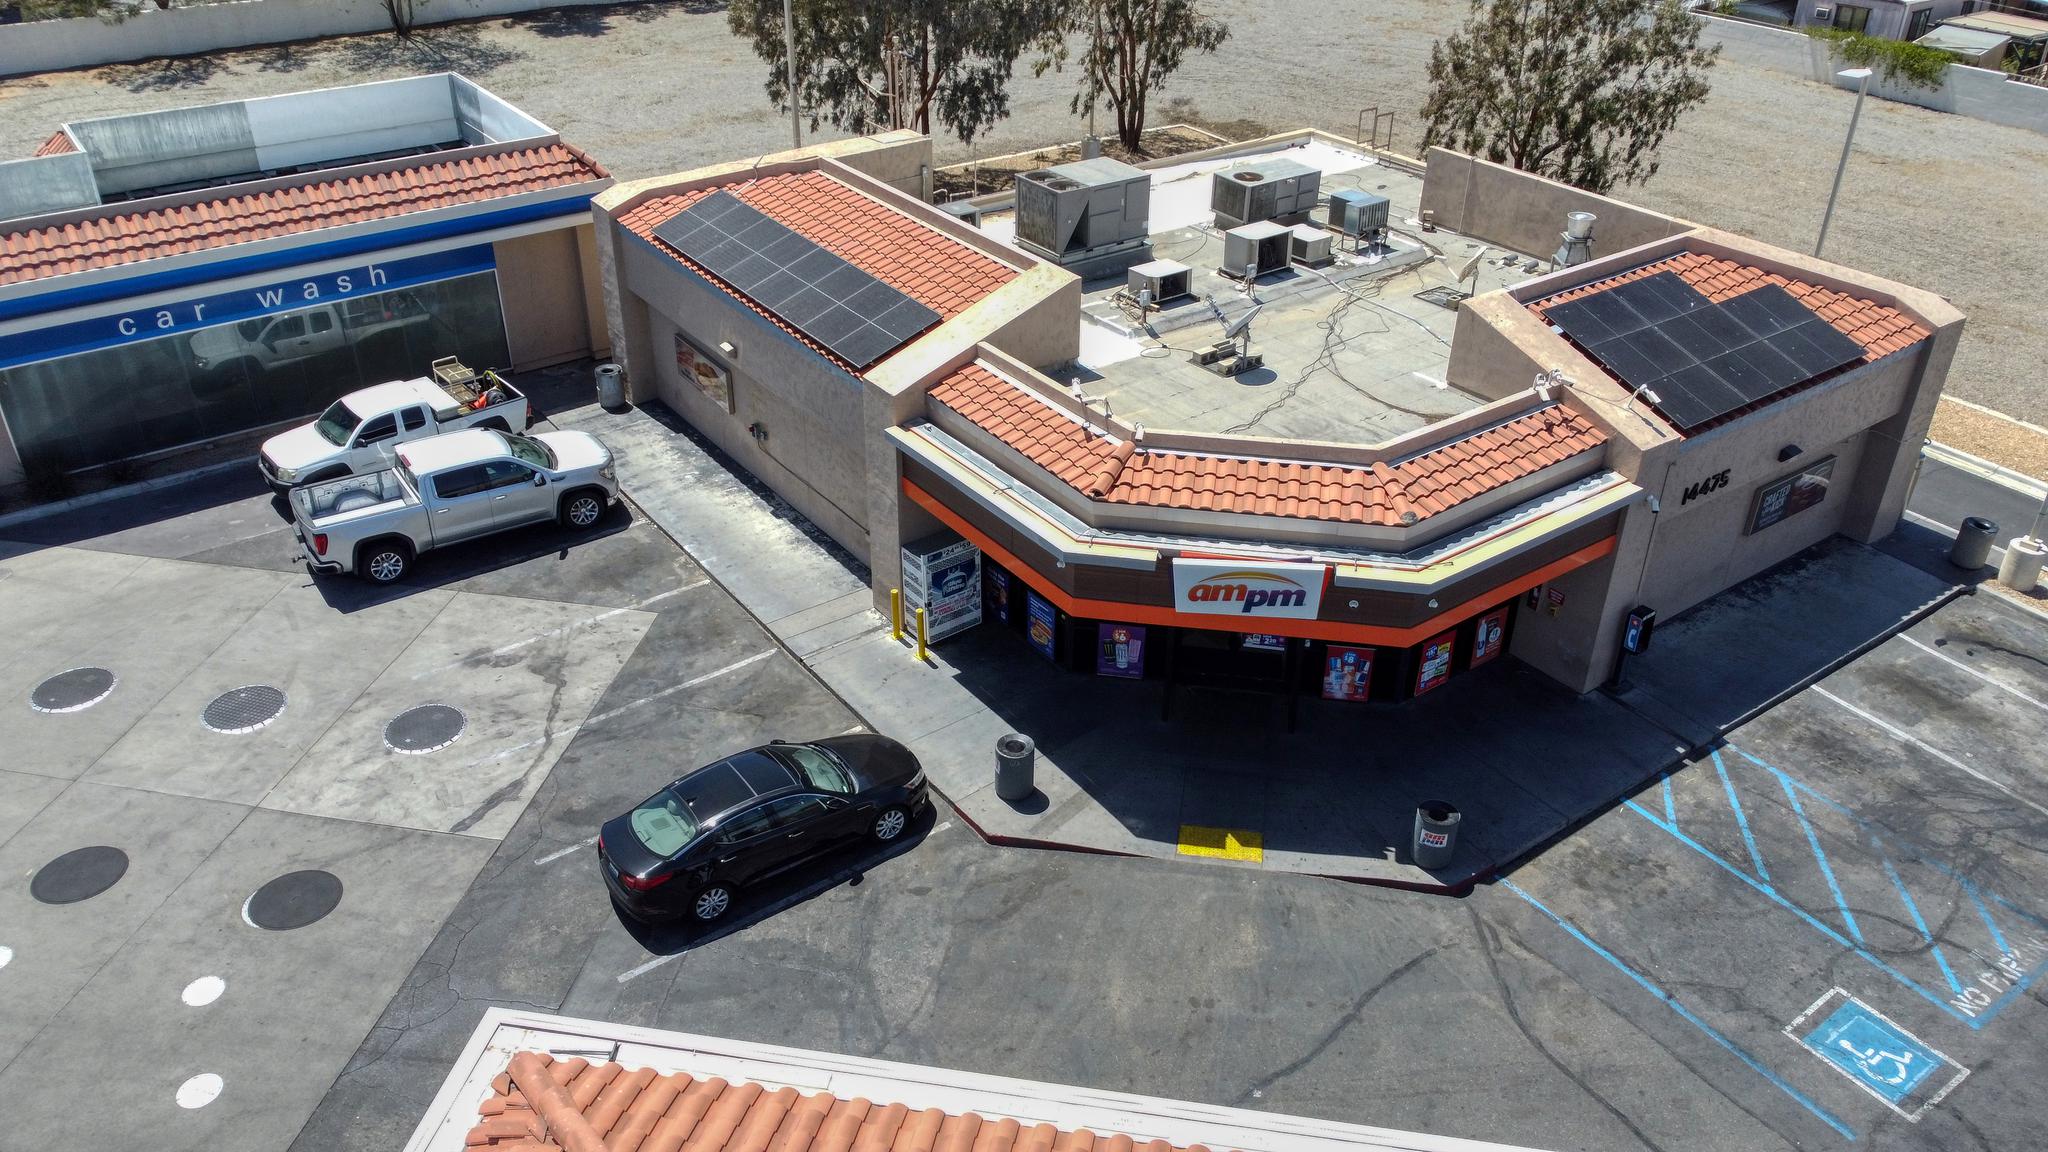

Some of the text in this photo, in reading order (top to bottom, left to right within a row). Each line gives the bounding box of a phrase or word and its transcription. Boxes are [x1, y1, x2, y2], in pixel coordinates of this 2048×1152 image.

[118, 265, 386, 336] car wash
[1681, 468, 1731, 506] 14475
[1188, 583, 1305, 614] ampm
[1950, 987, 1992, 1018] NO
